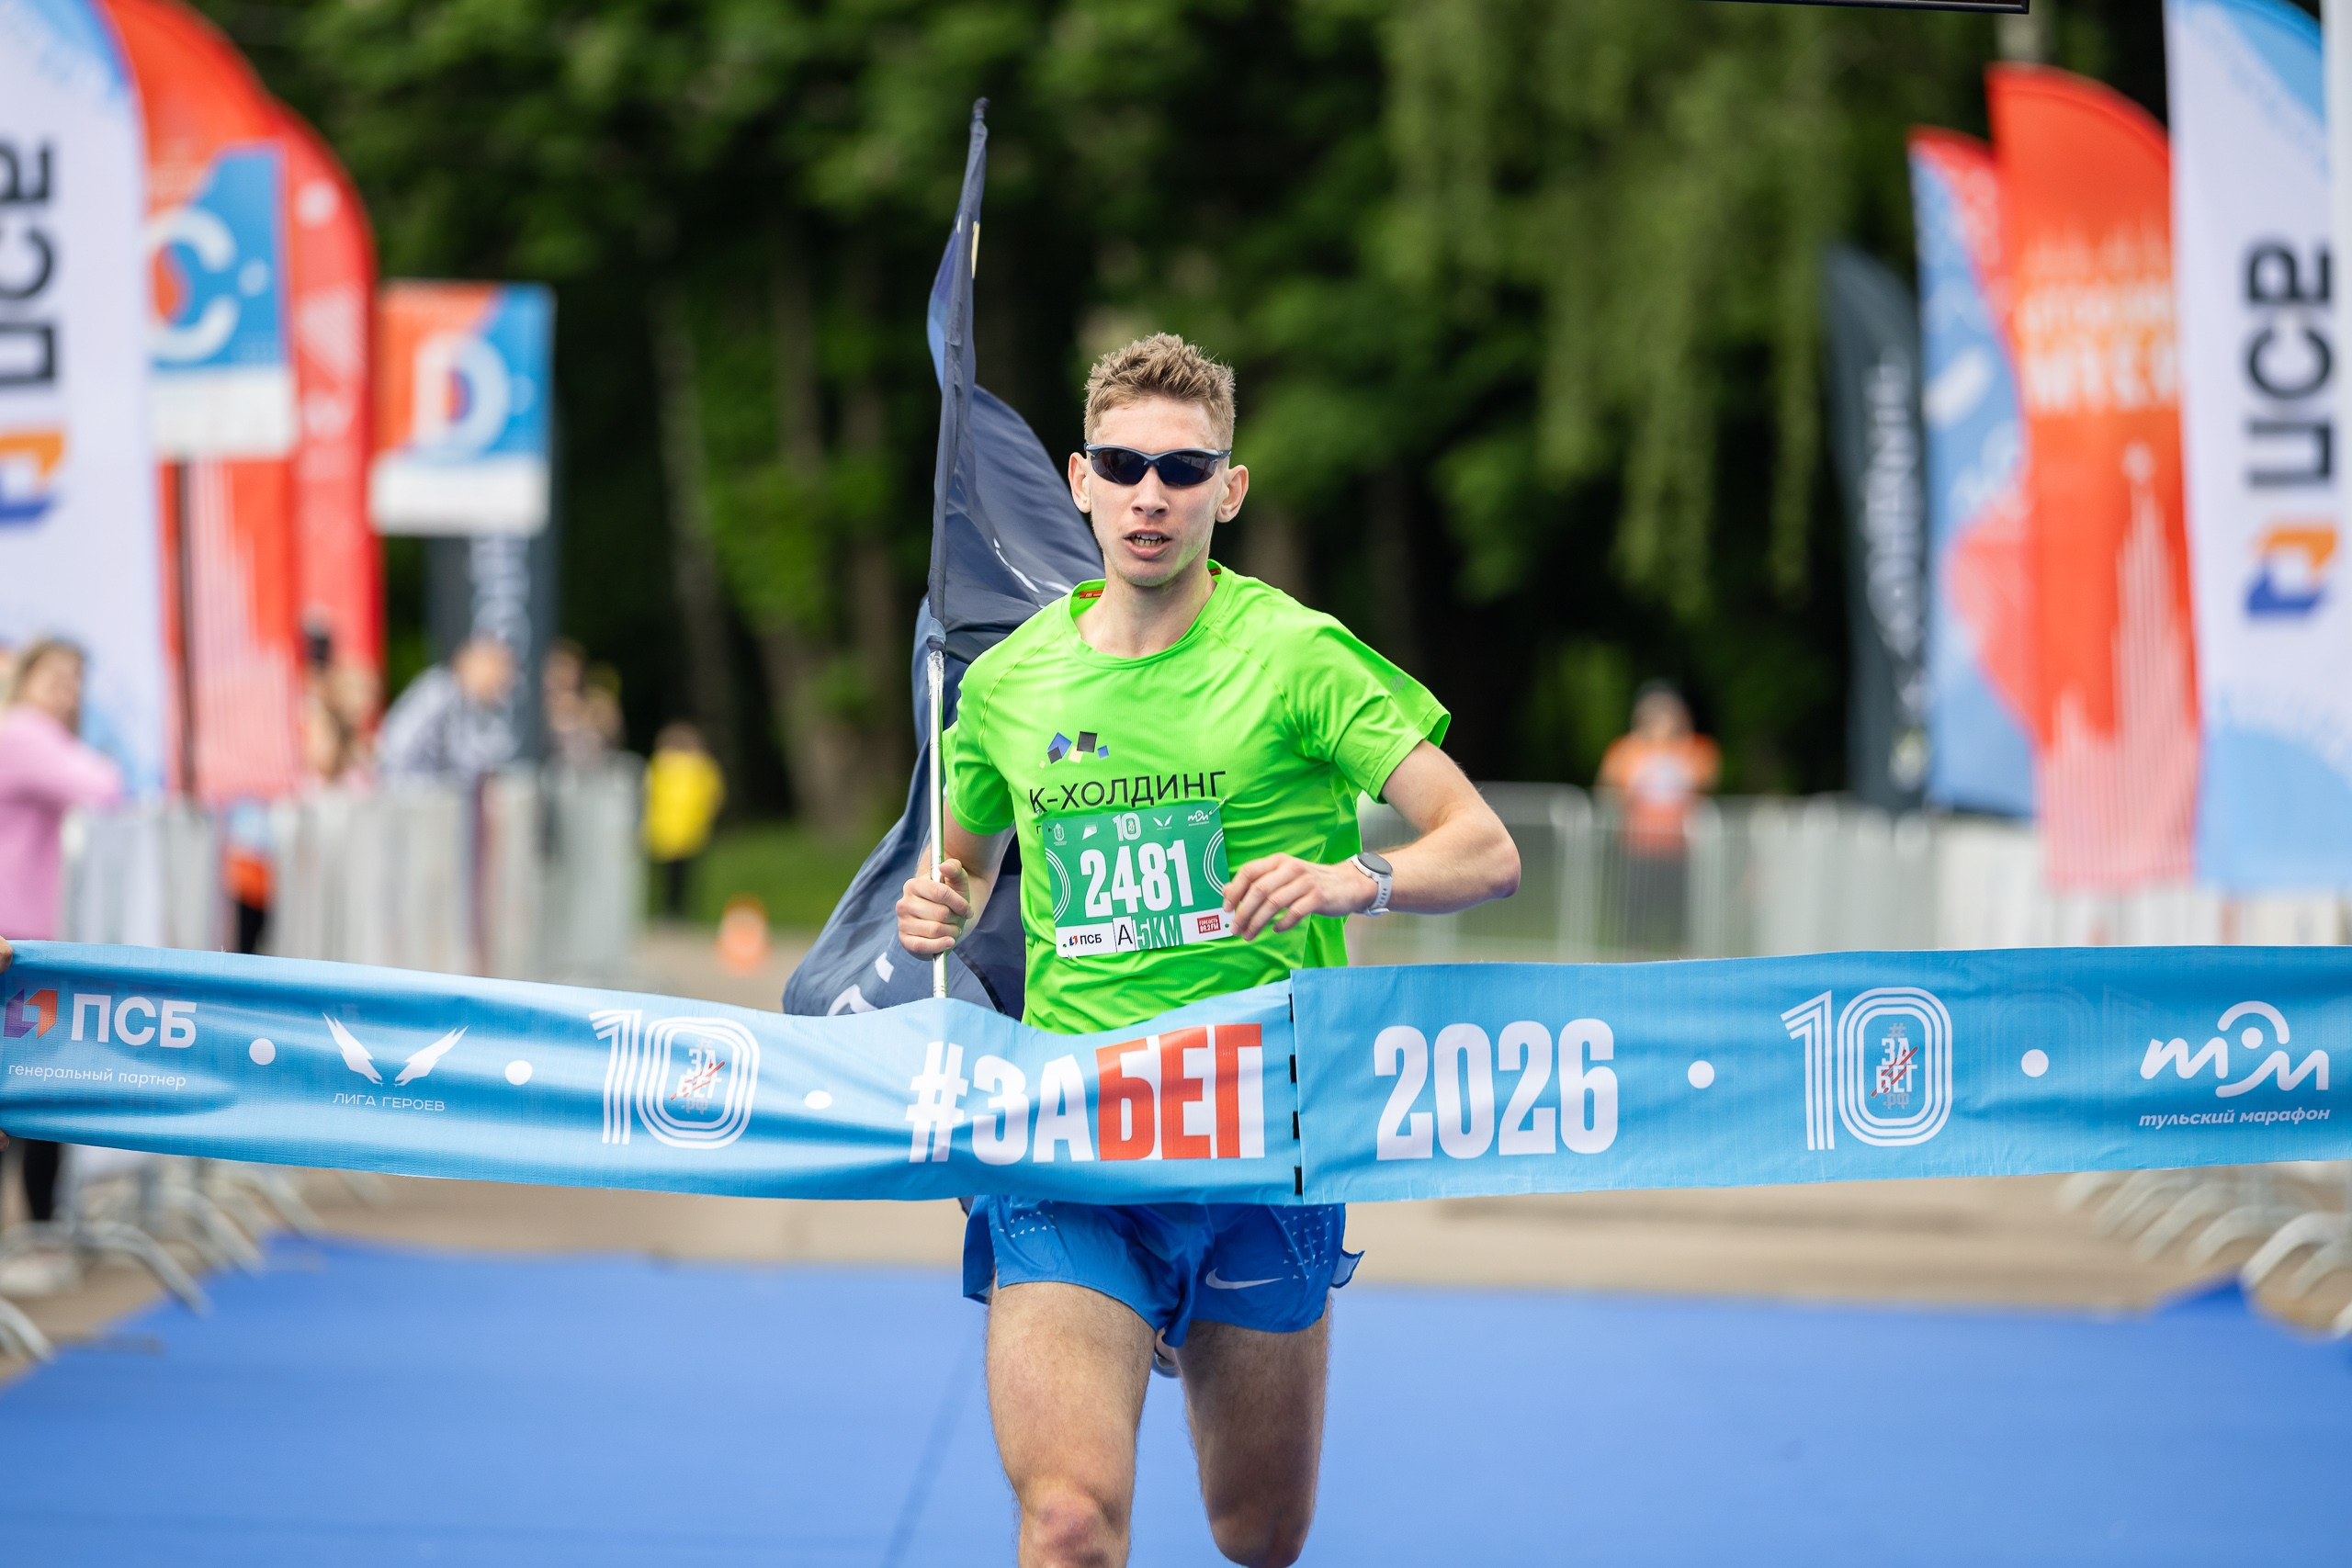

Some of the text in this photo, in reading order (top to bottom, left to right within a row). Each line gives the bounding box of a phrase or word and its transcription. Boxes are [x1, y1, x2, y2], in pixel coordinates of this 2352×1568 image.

[1029, 770, 1227, 813] К-ХОЛДИНГ
[1112, 812, 1142, 842] 10
[1080, 839, 1194, 919] 2481
[1079, 933, 1102, 945] ПСБ
[71, 993, 198, 1048] ПСБ
[7, 1065, 187, 1090] генеральный партнер
[588, 1010, 760, 1150] 10
[1373, 1018, 1619, 1163] 2026
[1781, 987, 1952, 1151] 10
[333, 1092, 446, 1111] ЛИГА ГЕРОЕВ
[2138, 1106, 2332, 1130] тульский марафон
